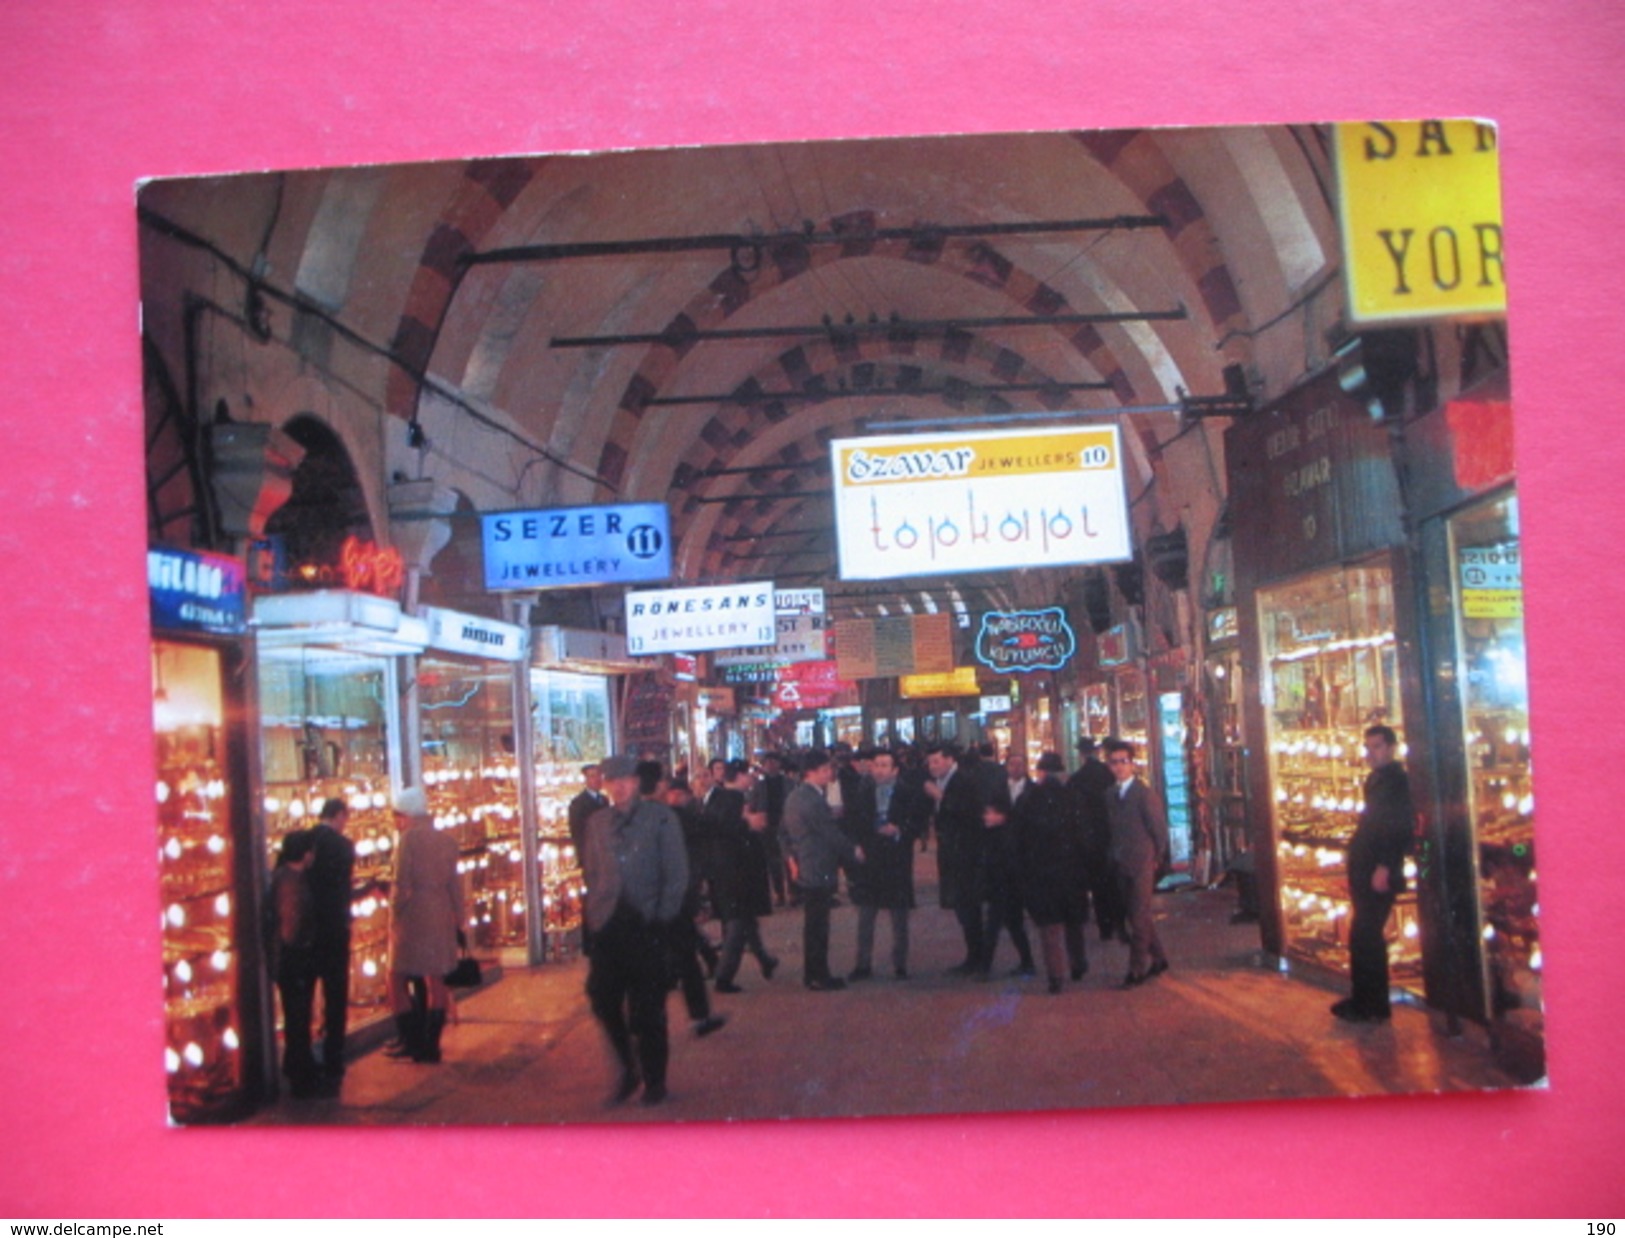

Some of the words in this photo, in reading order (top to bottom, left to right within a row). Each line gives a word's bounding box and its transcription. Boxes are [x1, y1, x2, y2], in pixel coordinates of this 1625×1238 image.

[978, 453, 1075, 471] JEWELLERS
[1082, 446, 1107, 466] 10
[494, 512, 623, 542] SEZER
[630, 527, 659, 556] 11
[632, 594, 768, 616] RÖNESANS
[652, 622, 749, 640] JEWELLERY
[758, 626, 772, 640] 13
[631, 637, 644, 650] 13
